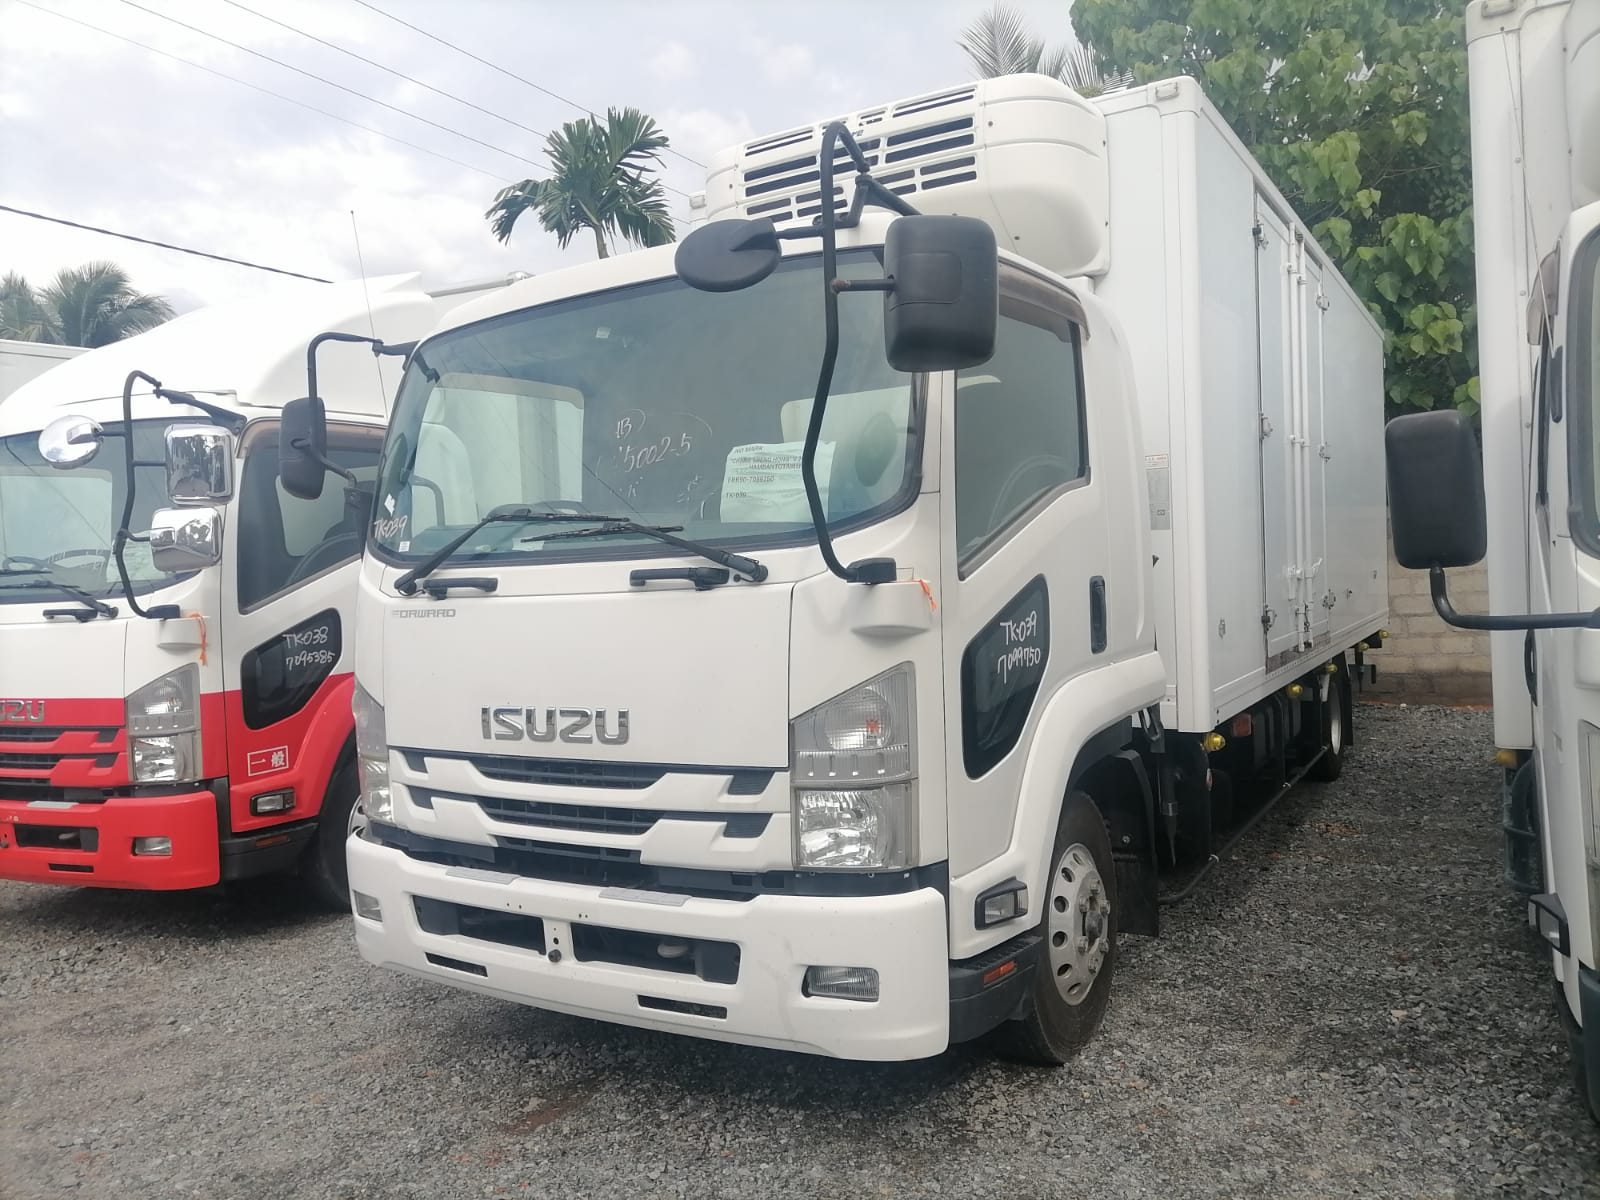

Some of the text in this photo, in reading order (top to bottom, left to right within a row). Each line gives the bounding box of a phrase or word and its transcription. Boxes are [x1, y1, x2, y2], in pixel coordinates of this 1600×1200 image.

[286, 650, 336, 671] 7095385
[997, 646, 1041, 685] 7099750
[481, 705, 630, 746] ISUZU
[250, 750, 286, 768] 一般
